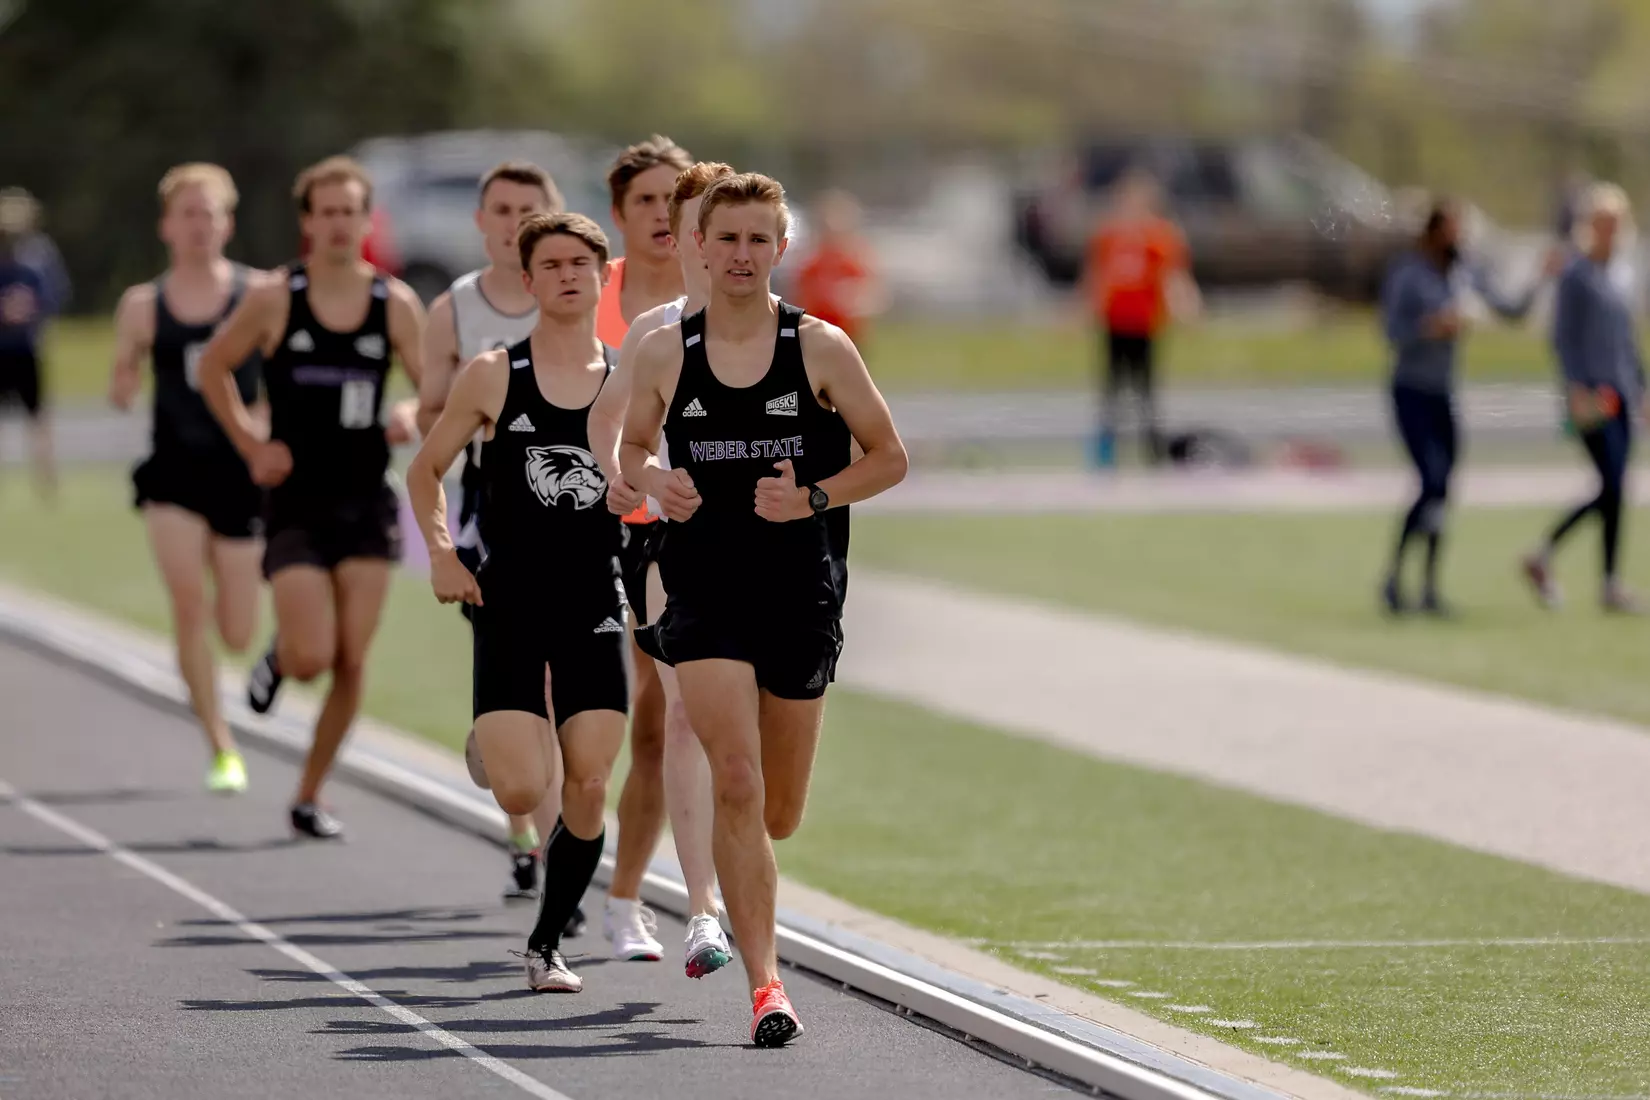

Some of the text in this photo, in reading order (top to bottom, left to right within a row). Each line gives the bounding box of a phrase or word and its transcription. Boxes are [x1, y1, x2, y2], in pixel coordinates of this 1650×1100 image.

[682, 409, 707, 417] adidas
[690, 435, 804, 462] WEBER STATE
